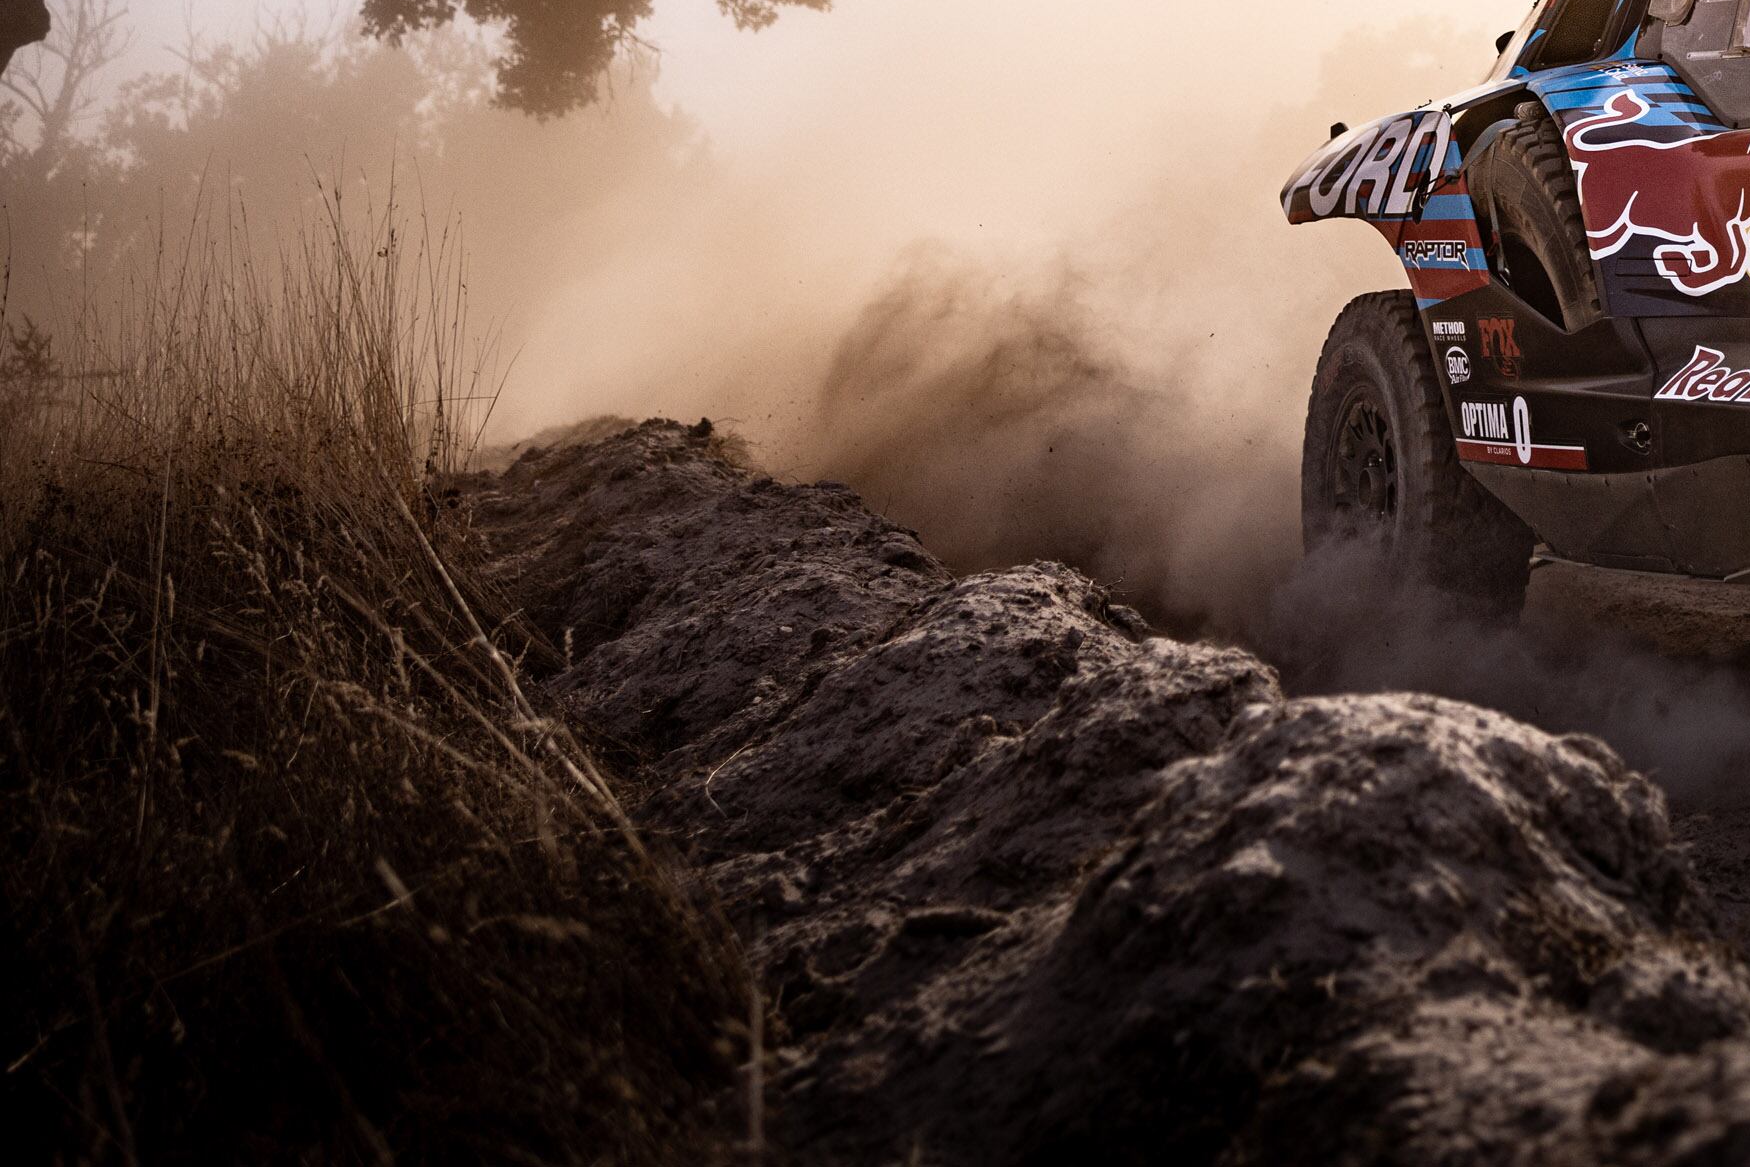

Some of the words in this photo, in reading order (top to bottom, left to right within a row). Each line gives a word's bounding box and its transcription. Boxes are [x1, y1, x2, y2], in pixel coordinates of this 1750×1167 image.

[1283, 111, 1451, 216] FORD
[1404, 240, 1471, 272] RAPTOR
[1433, 321, 1465, 335] METHOD
[1478, 316, 1521, 358] FOX
[1447, 356, 1469, 375] BMC
[1461, 401, 1509, 439] OPTIMA
[1487, 446, 1493, 454] BY
[1493, 447, 1512, 456] CLARIOS
